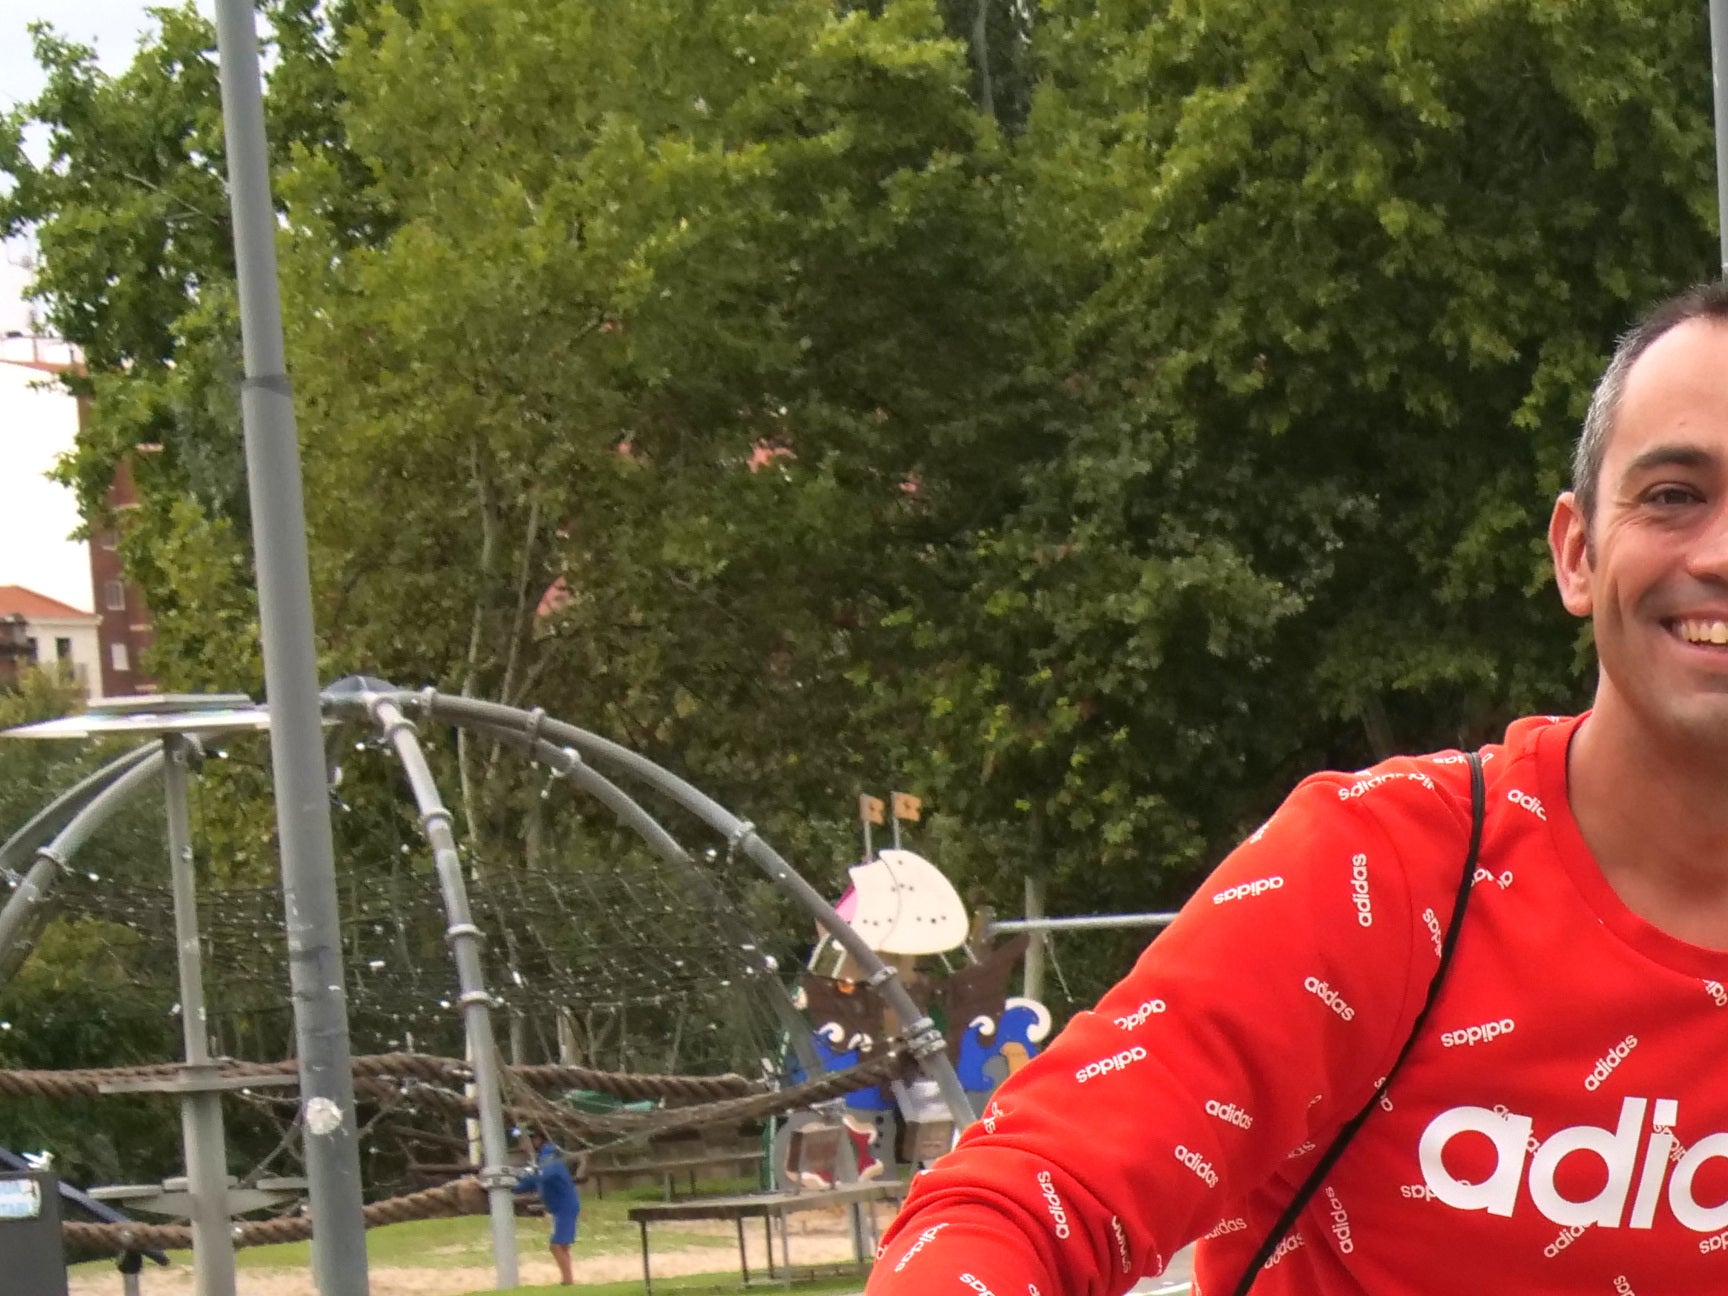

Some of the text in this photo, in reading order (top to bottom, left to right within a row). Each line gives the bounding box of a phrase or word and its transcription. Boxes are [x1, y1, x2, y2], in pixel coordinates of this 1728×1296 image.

[1213, 876, 1285, 904] adidas
[1351, 853, 1373, 928] adidas
[1441, 1018, 1515, 1047] adidas
[1076, 1046, 1148, 1083] adidas
[1584, 1034, 1638, 1092] adidas
[1205, 1099, 1253, 1131] adidas
[1174, 1144, 1219, 1188] adidas
[1036, 1170, 1070, 1240] adidas
[1325, 1185, 1354, 1254] adidas
